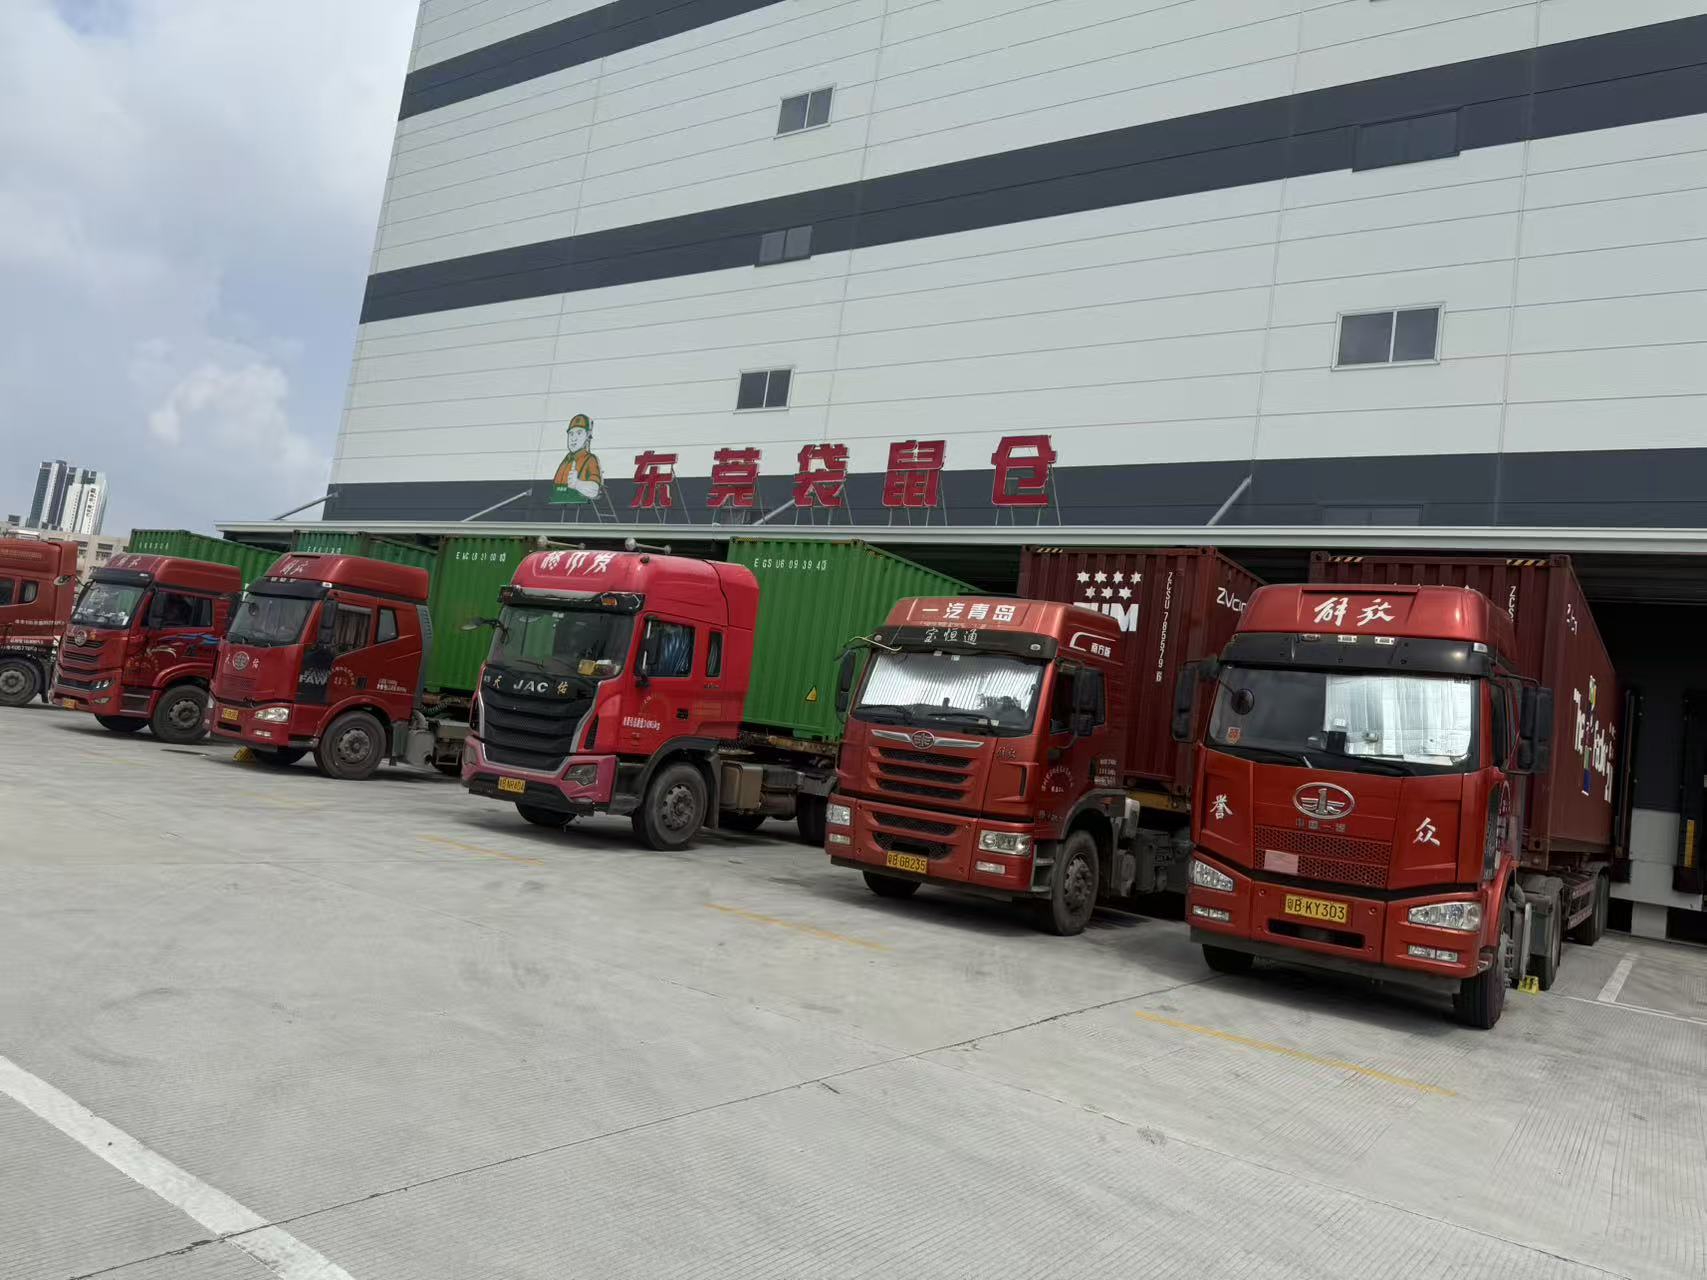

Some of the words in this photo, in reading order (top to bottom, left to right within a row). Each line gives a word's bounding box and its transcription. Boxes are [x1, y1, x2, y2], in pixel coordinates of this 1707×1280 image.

[631, 434, 1057, 508] 东莞袋鼠仓
[922, 602, 1016, 622] 一汽青岛
[1314, 597, 1396, 627] 解放
[1508, 585, 1517, 623] ZCS
[513, 679, 549, 693] JAC
[1413, 817, 1440, 846] 众
